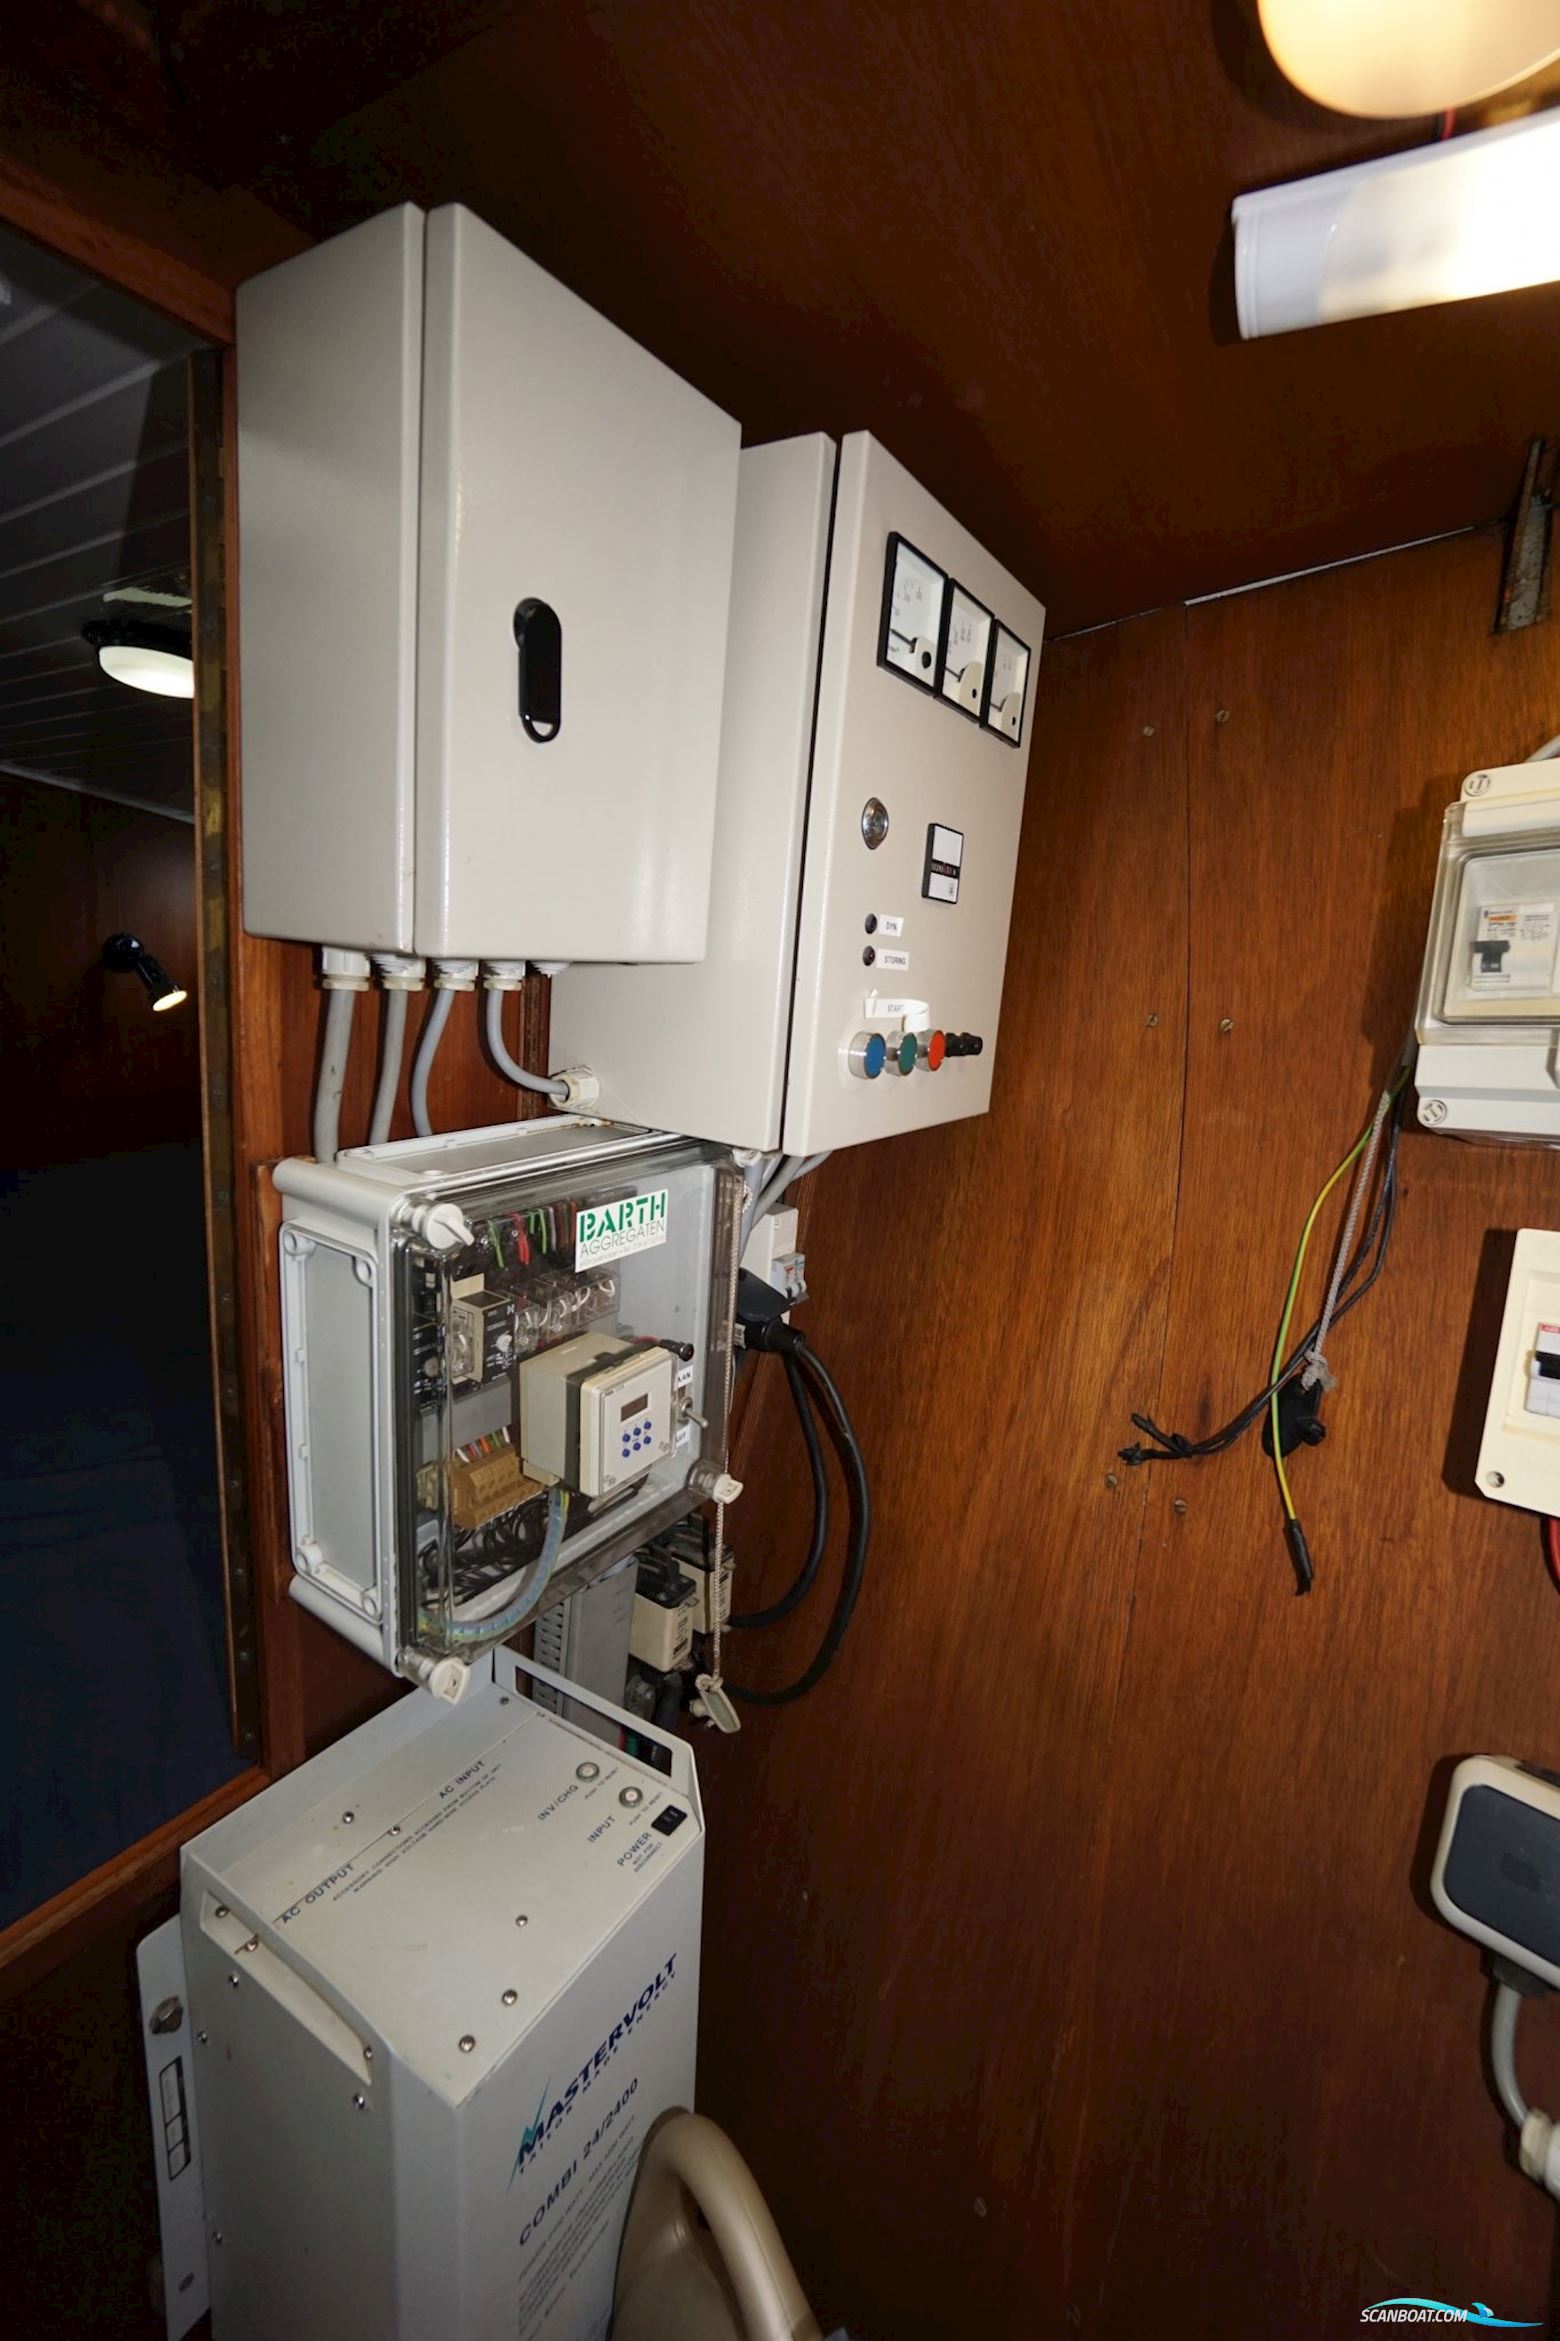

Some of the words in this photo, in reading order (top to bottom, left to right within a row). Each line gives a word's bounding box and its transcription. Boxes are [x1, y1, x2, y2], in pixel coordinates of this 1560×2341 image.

[887, 1003, 905, 1014] START
[579, 1192, 665, 1243] BARTH
[580, 1219, 665, 1257] AGGREGATEN
[439, 1785, 454, 1800] AC
[455, 1760, 485, 1785] INPUT
[537, 1784, 579, 1821] INV/CHG
[587, 1815, 616, 1843] INPUT
[617, 1831, 652, 1866] POWER
[282, 1905, 301, 1924] AC
[305, 1863, 354, 1904] OUTPUT
[519, 1953, 677, 2167] MASTERVOLT
[582, 2047, 618, 2094] MADE
[519, 2159, 577, 2246] COMBI
[583, 2077, 638, 2160] 24/2400
